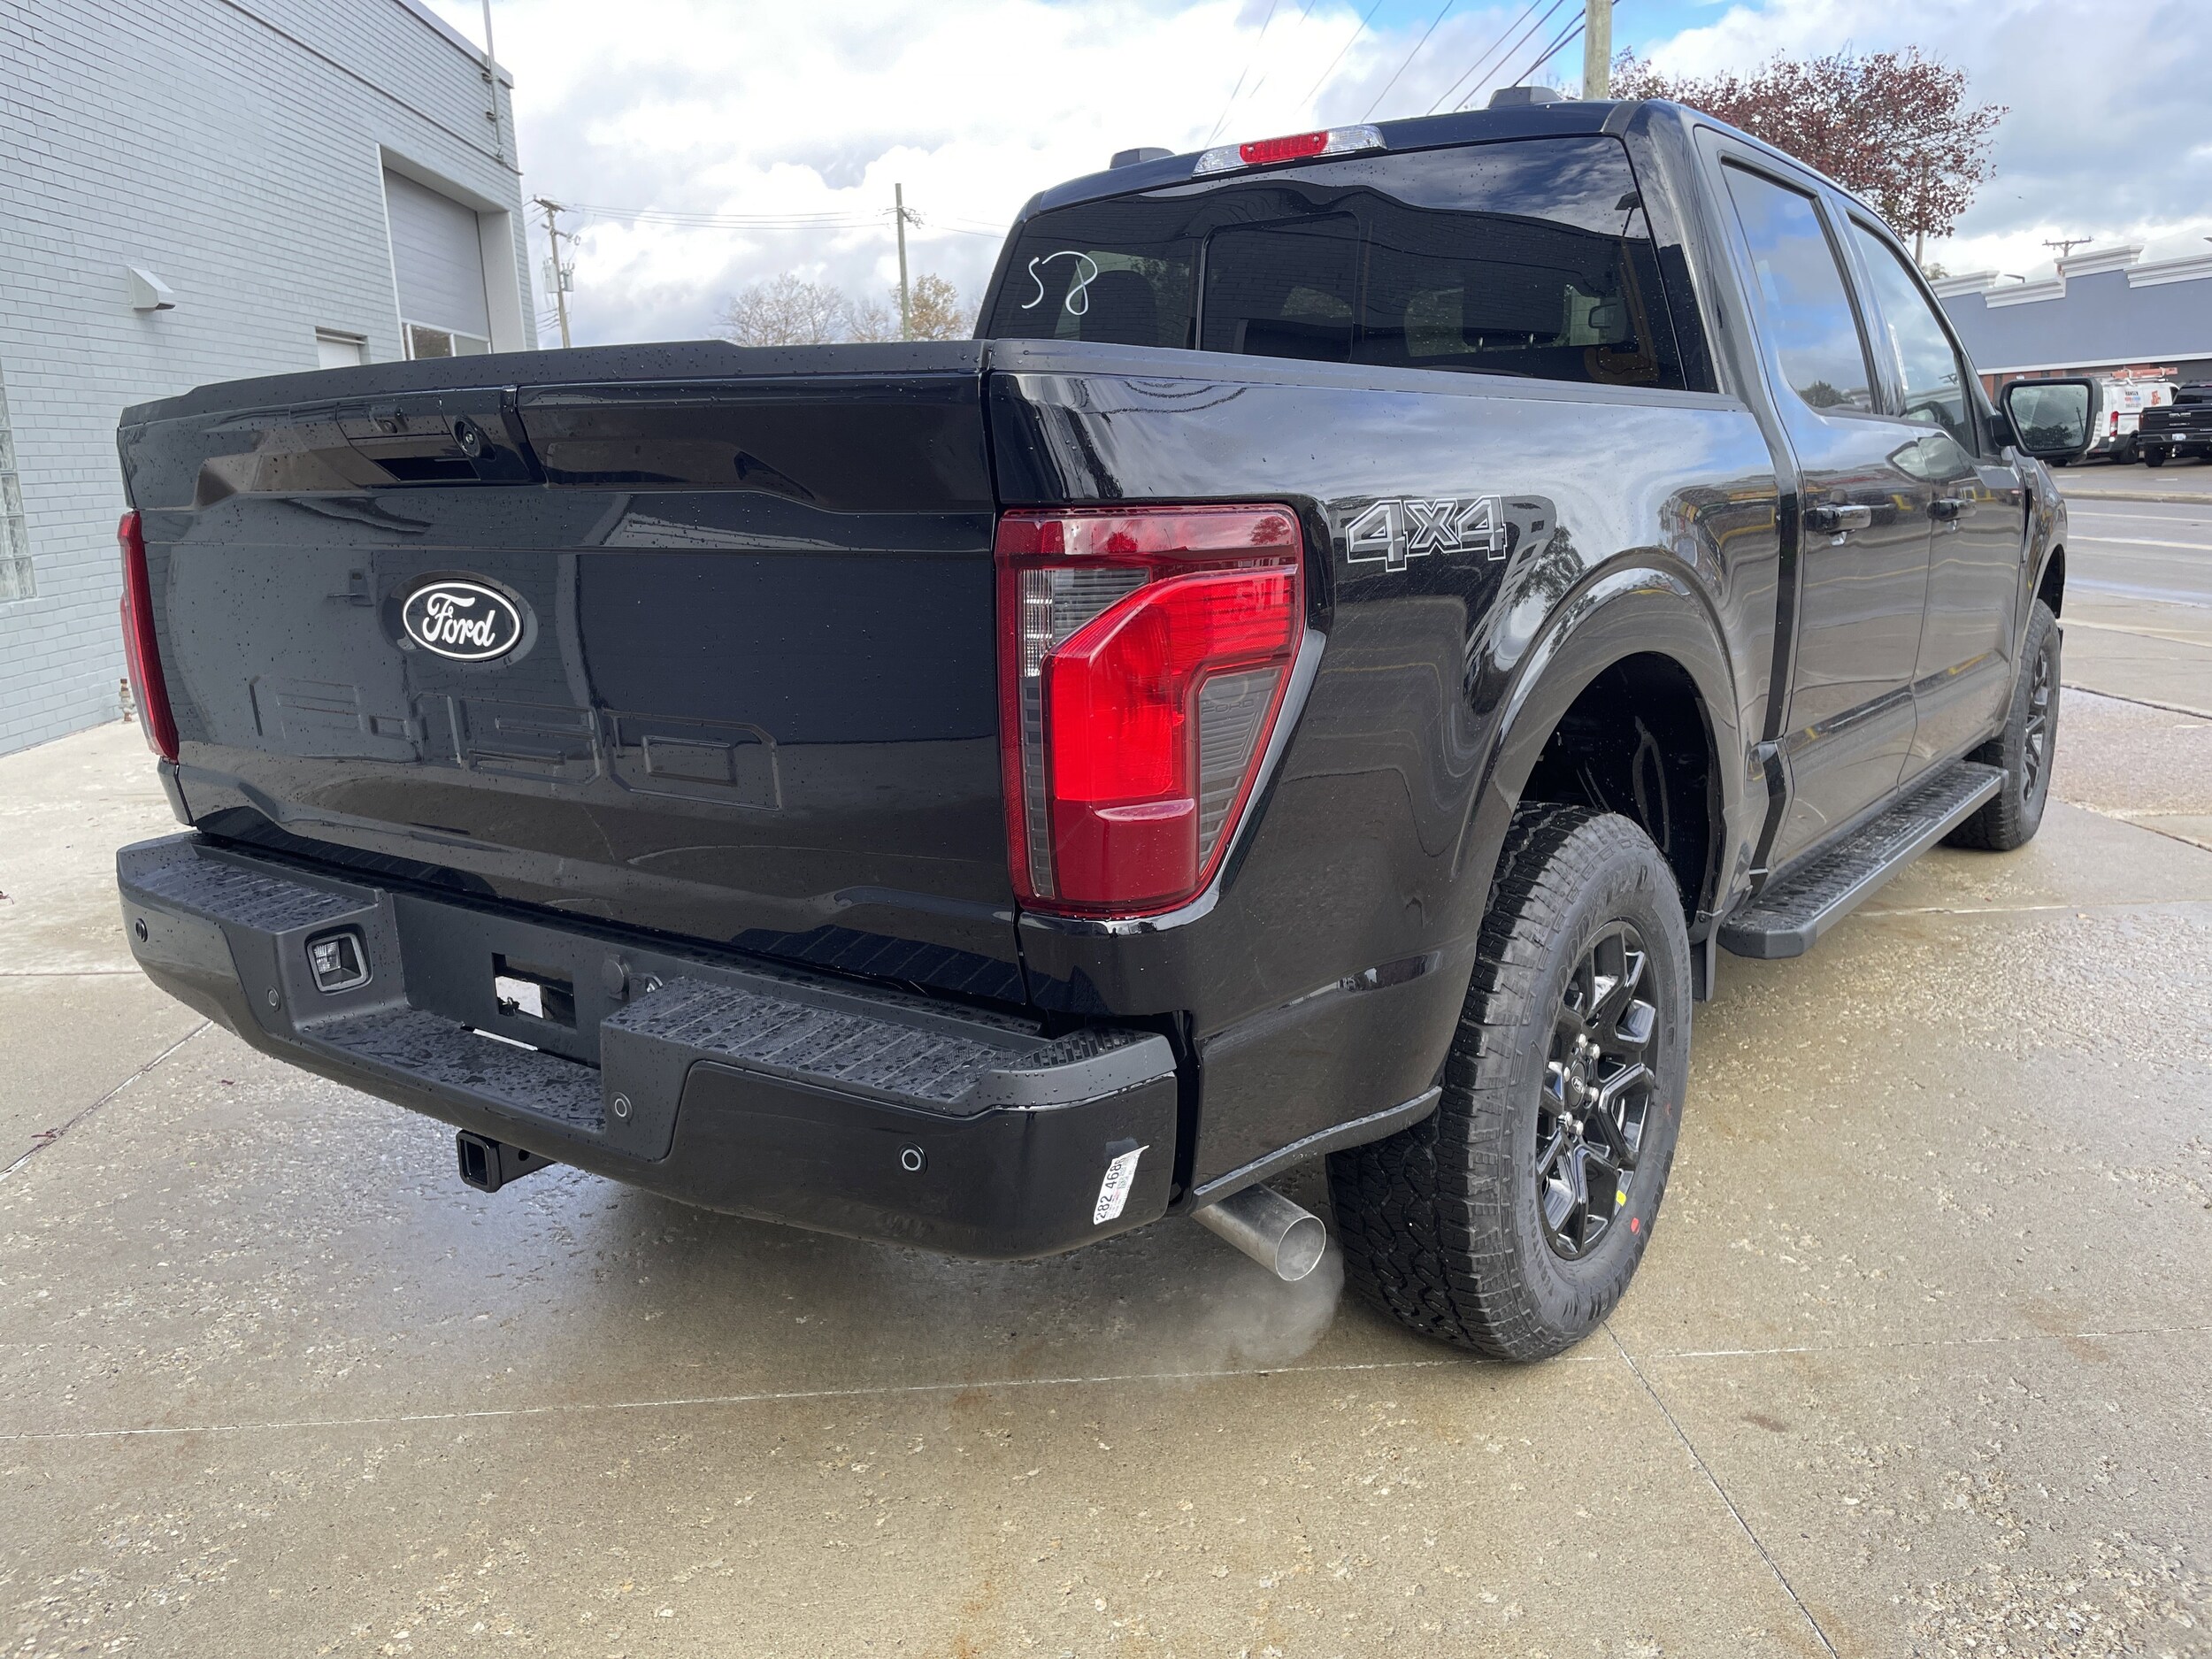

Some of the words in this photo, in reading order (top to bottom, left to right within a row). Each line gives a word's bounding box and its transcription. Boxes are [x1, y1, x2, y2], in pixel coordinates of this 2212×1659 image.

[422, 593, 496, 647] Ford
[1201, 699, 1255, 716] FORD
[249, 673, 783, 811] F-150
[1095, 1194, 1114, 1221] 282
